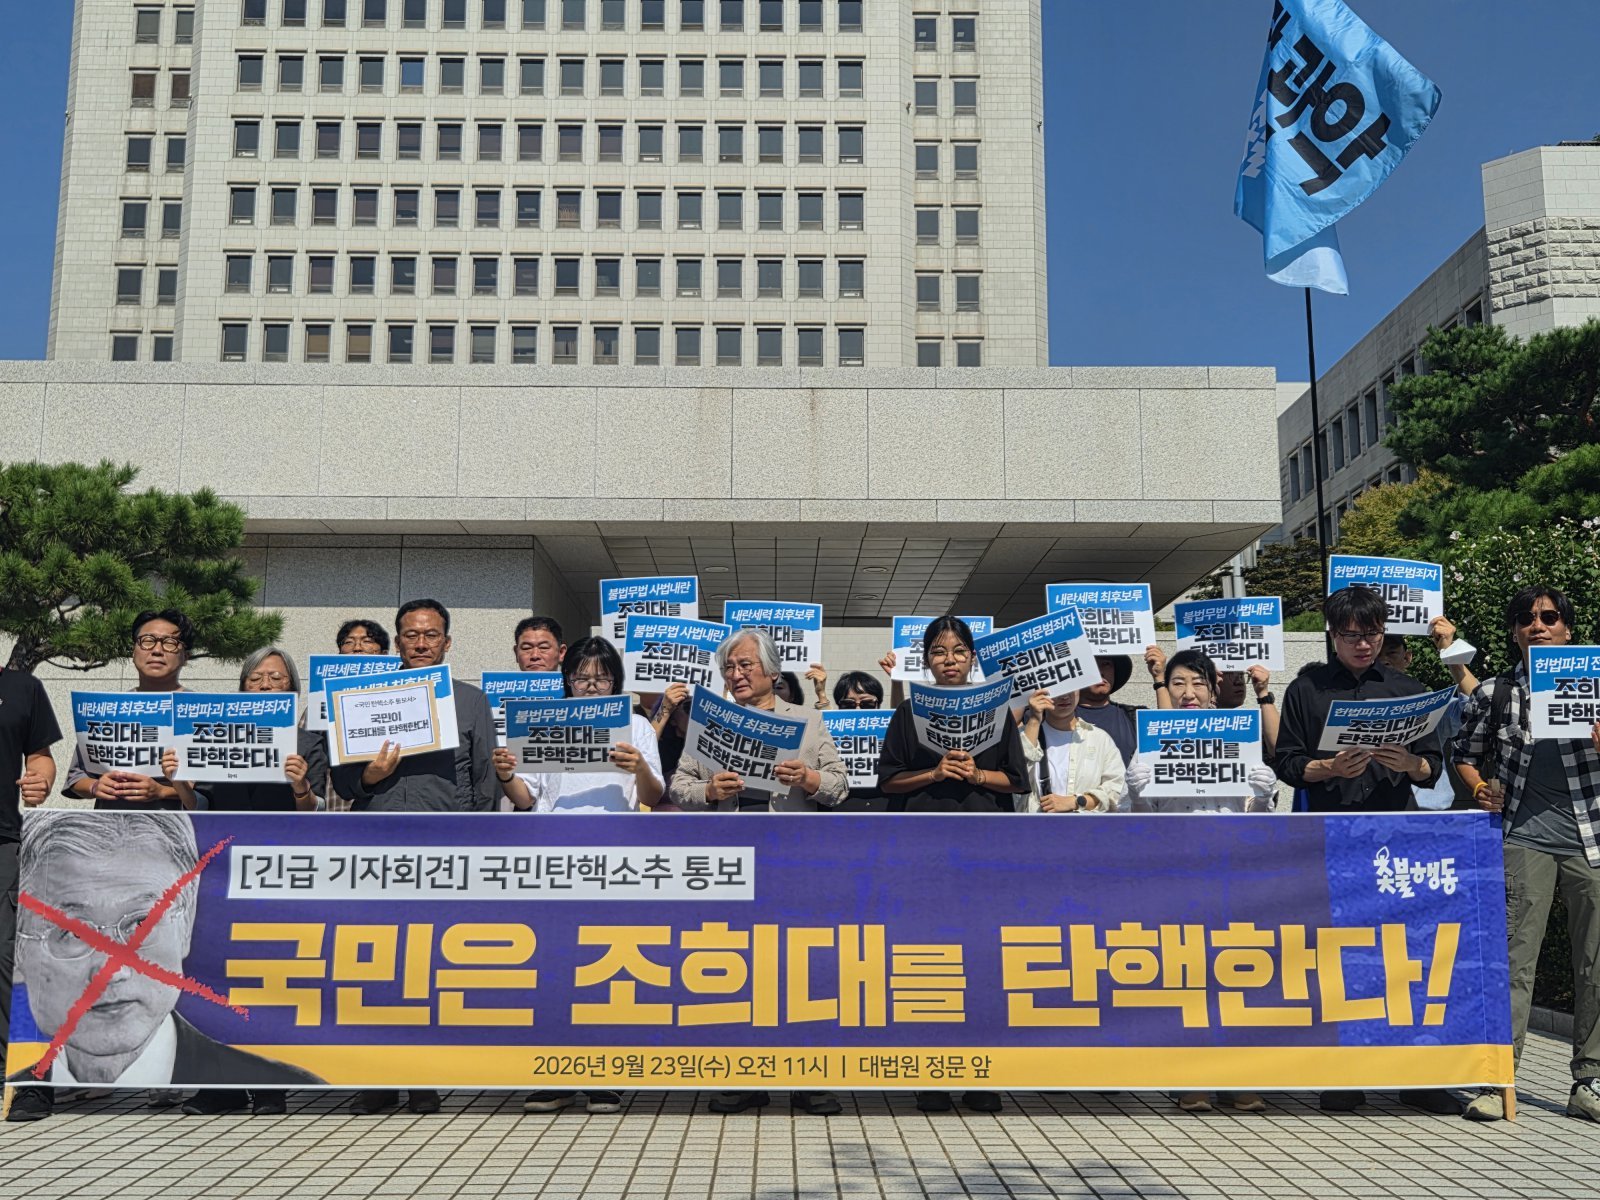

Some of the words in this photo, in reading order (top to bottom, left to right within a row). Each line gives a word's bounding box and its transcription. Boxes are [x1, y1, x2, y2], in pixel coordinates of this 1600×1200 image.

[1334, 565, 1380, 578] 헌법파괴
[1381, 565, 1438, 581] 전문범죄자
[608, 585, 648, 600] 불법무법
[649, 581, 691, 596] 사법내란
[1055, 591, 1099, 606] 내란세력
[1100, 589, 1143, 604] 최후보루
[1349, 582, 1424, 603] 희대를
[618, 601, 681, 618] 조희대를
[731, 609, 773, 622] 내란세력
[773, 608, 815, 621] 최후보루
[1183, 605, 1227, 624] 불법무법
[1228, 602, 1275, 618] 사법내란
[1386, 604, 1429, 624] 한다!
[633, 624, 680, 638] 불법무법
[680, 626, 724, 643] 사법내란
[978, 633, 1021, 661] 헌법파괴
[1021, 612, 1076, 644] 전문범죄자
[1085, 627, 1142, 645] 핵한다!
[1194, 622, 1264, 642] 조희대를
[642, 641, 711, 666] 조희대를
[998, 641, 1071, 677] 조희대를
[316, 662, 362, 677] 내란세력
[635, 662, 713, 687] 탄핵한다!
[1535, 656, 1589, 674] 헌법파괴
[485, 680, 528, 694] 헌법파괴
[529, 677, 564, 691] 전문범
[914, 692, 960, 710] 헌법파괴
[961, 680, 1011, 710] 전문범죄자
[77, 701, 118, 717] 내란세력
[119, 699, 172, 716] 최후보루
[176, 702, 224, 718] 헌법파괴
[226, 699, 291, 717] 전문범죄자
[515, 707, 568, 724] 불법무법
[569, 701, 623, 720] 사법내란
[1334, 706, 1390, 717] 헌법파괴
[1389, 690, 1451, 716] 전문범죄자
[370, 711, 403, 724] 국민이
[699, 698, 745, 728] 내란세력
[743, 718, 798, 739] 최후보루
[824, 717, 857, 733] 란세력
[857, 716, 892, 731] 최후보
[929, 707, 996, 734] 조희대를
[1147, 718, 1199, 736] 불법무법
[1200, 715, 1253, 732] 사법내란
[87, 720, 159, 742] 조희대를
[192, 721, 274, 744] 조희대를
[347, 725, 387, 739] 조희대를
[388, 719, 430, 735] 탄핵한다!
[528, 725, 611, 744] 조희대를
[704, 717, 779, 761] 조희대를
[187, 746, 280, 768] 탄핵한다!
[1159, 738, 1240, 760] 조희대를
[1154, 762, 1246, 784] 탄핵한다!
[240, 854, 319, 890] [긴급
[328, 854, 470, 891] 기자회견]
[479, 854, 674, 891] 국민탄핵소추
[681, 854, 747, 891] 통보
[1373, 846, 1459, 899] 촛불행동
[225, 922, 538, 1027] 국민은
[571, 922, 966, 1027] 조희대를
[1000, 921, 1461, 1028] 탄핵한다!
[533, 1055, 606, 1079] 2026년
[611, 1055, 645, 1078] 9월
[650, 1055, 731, 1079] 23일(수)
[735, 1055, 776, 1078] 오전
[783, 1055, 828, 1079] 11시
[859, 1055, 920, 1079] 대법원
[925, 1055, 967, 1079] 정문
[971, 1055, 992, 1079] 앞
